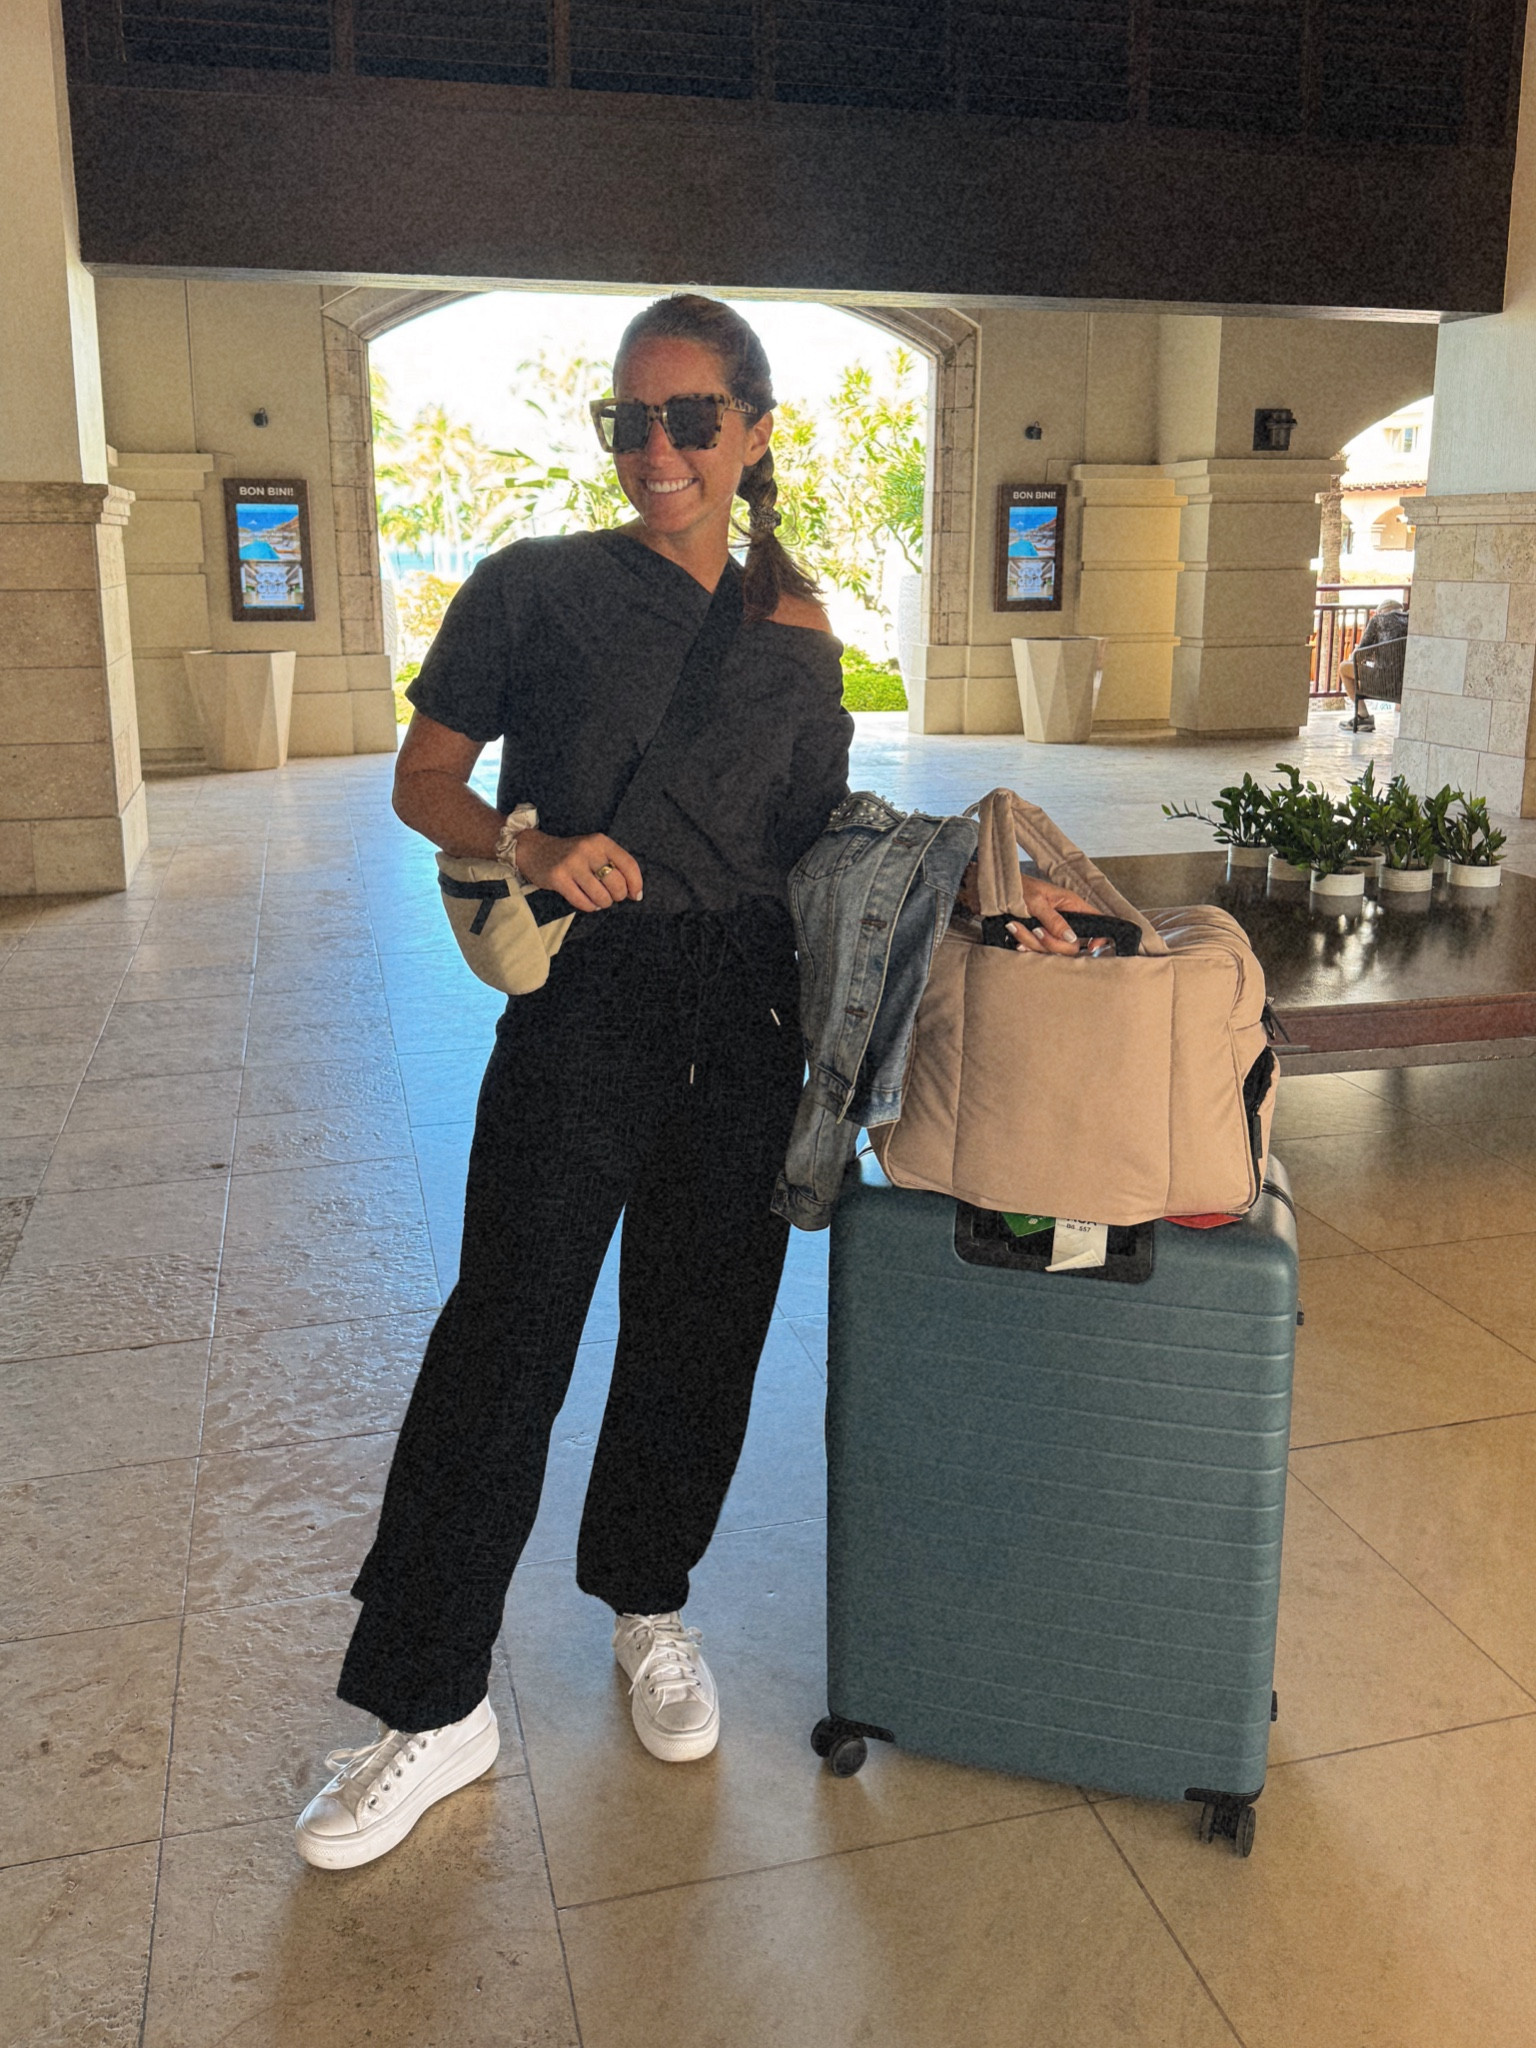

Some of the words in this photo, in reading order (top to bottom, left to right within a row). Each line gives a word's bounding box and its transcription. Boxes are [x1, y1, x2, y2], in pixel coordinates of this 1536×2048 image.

[239, 486, 265, 496] BON
[267, 487, 294, 497] BINI!
[1013, 491, 1033, 500] BON
[1035, 491, 1057, 500] BINI!
